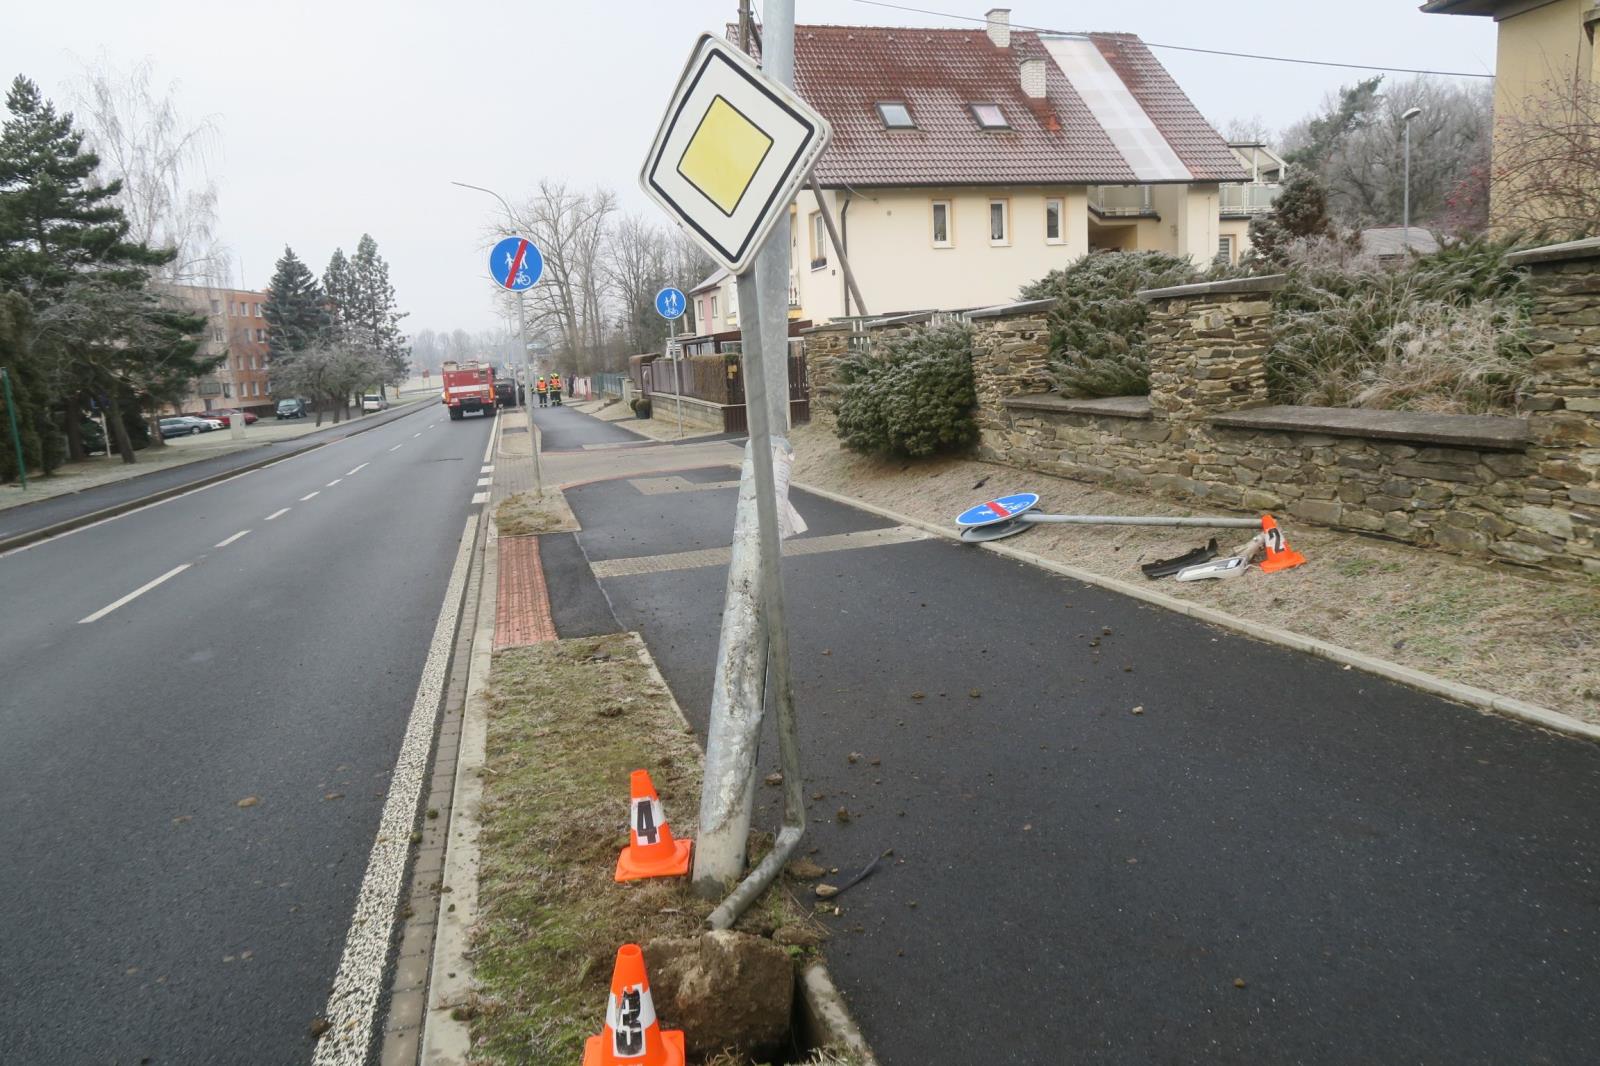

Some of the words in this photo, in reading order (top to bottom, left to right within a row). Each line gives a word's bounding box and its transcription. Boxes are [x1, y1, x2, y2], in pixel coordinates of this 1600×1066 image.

[1267, 528, 1284, 553] 2
[637, 800, 657, 844] 4
[615, 989, 643, 1056] 3
